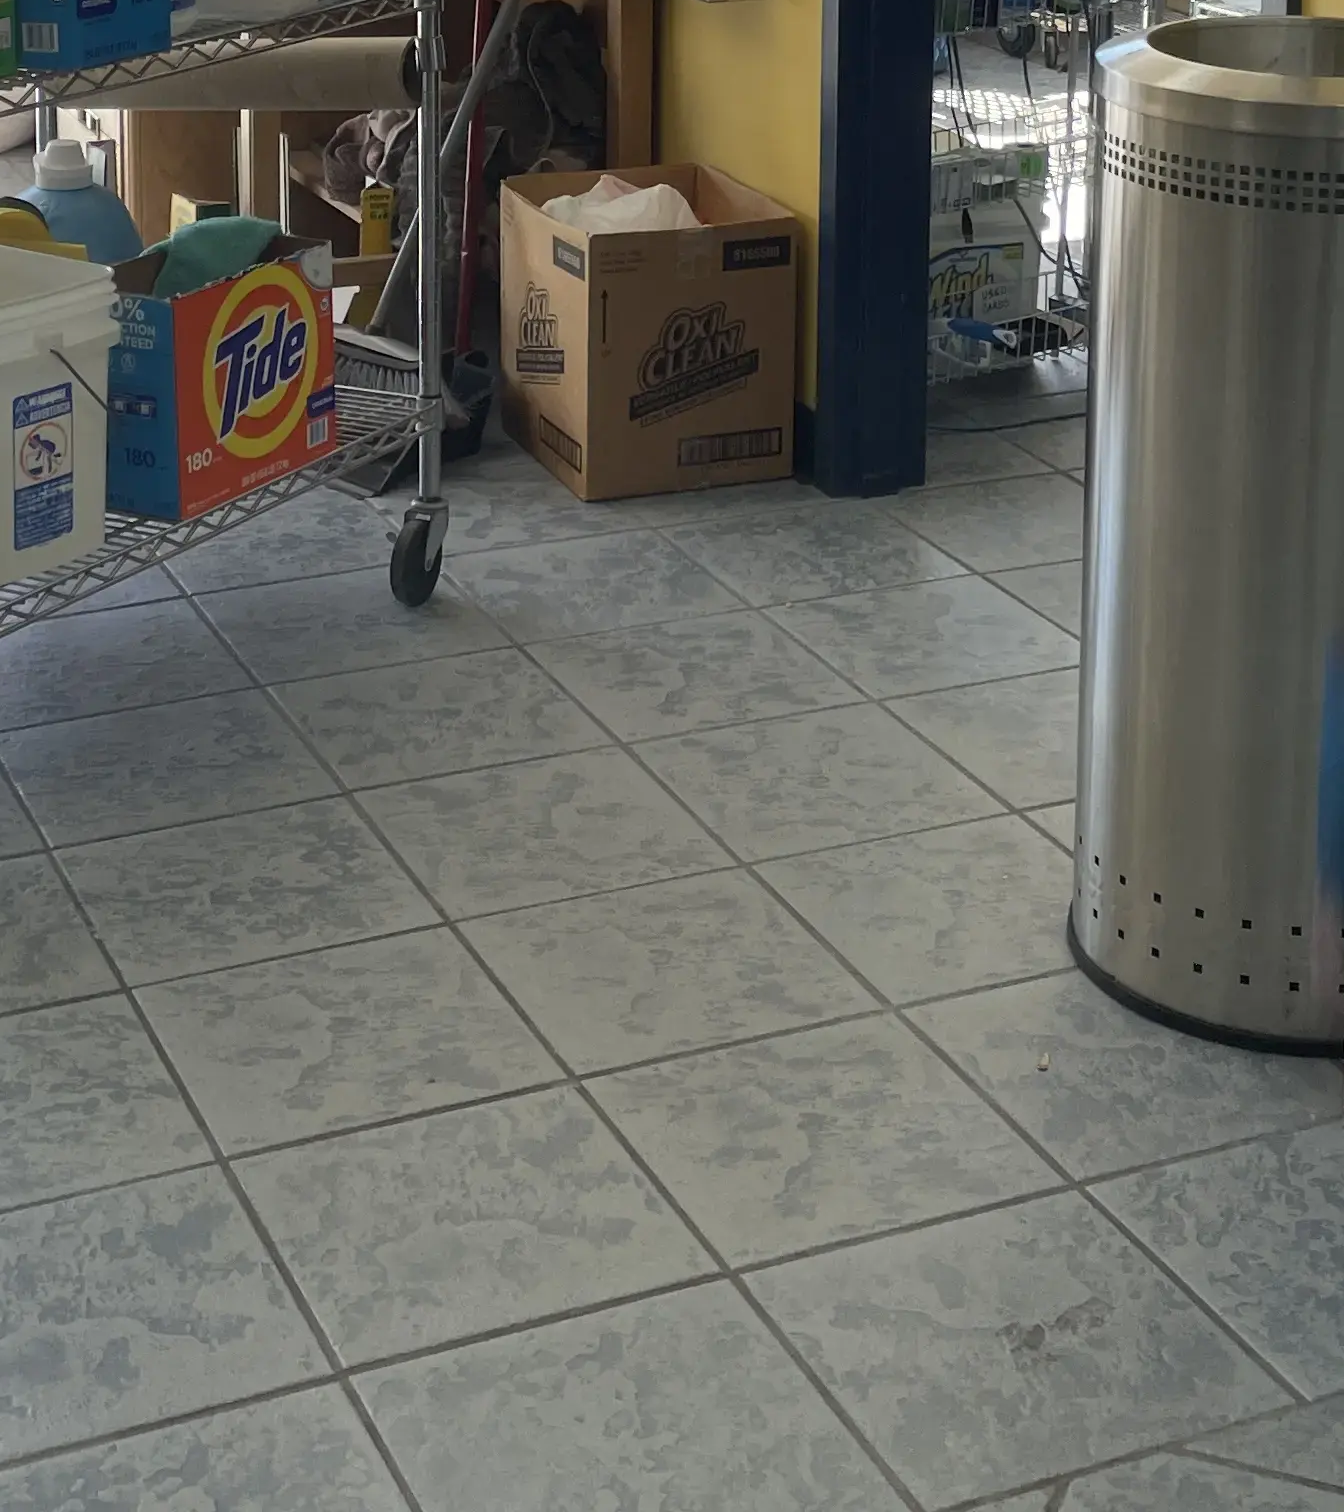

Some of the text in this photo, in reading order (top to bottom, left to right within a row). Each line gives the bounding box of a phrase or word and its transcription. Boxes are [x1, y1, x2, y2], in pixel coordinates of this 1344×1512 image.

[521, 316, 555, 348] CLEAN
[214, 302, 307, 444] Tide
[643, 326, 740, 389] CLEAN
[125, 447, 155, 469] 180
[186, 448, 213, 474] 180
